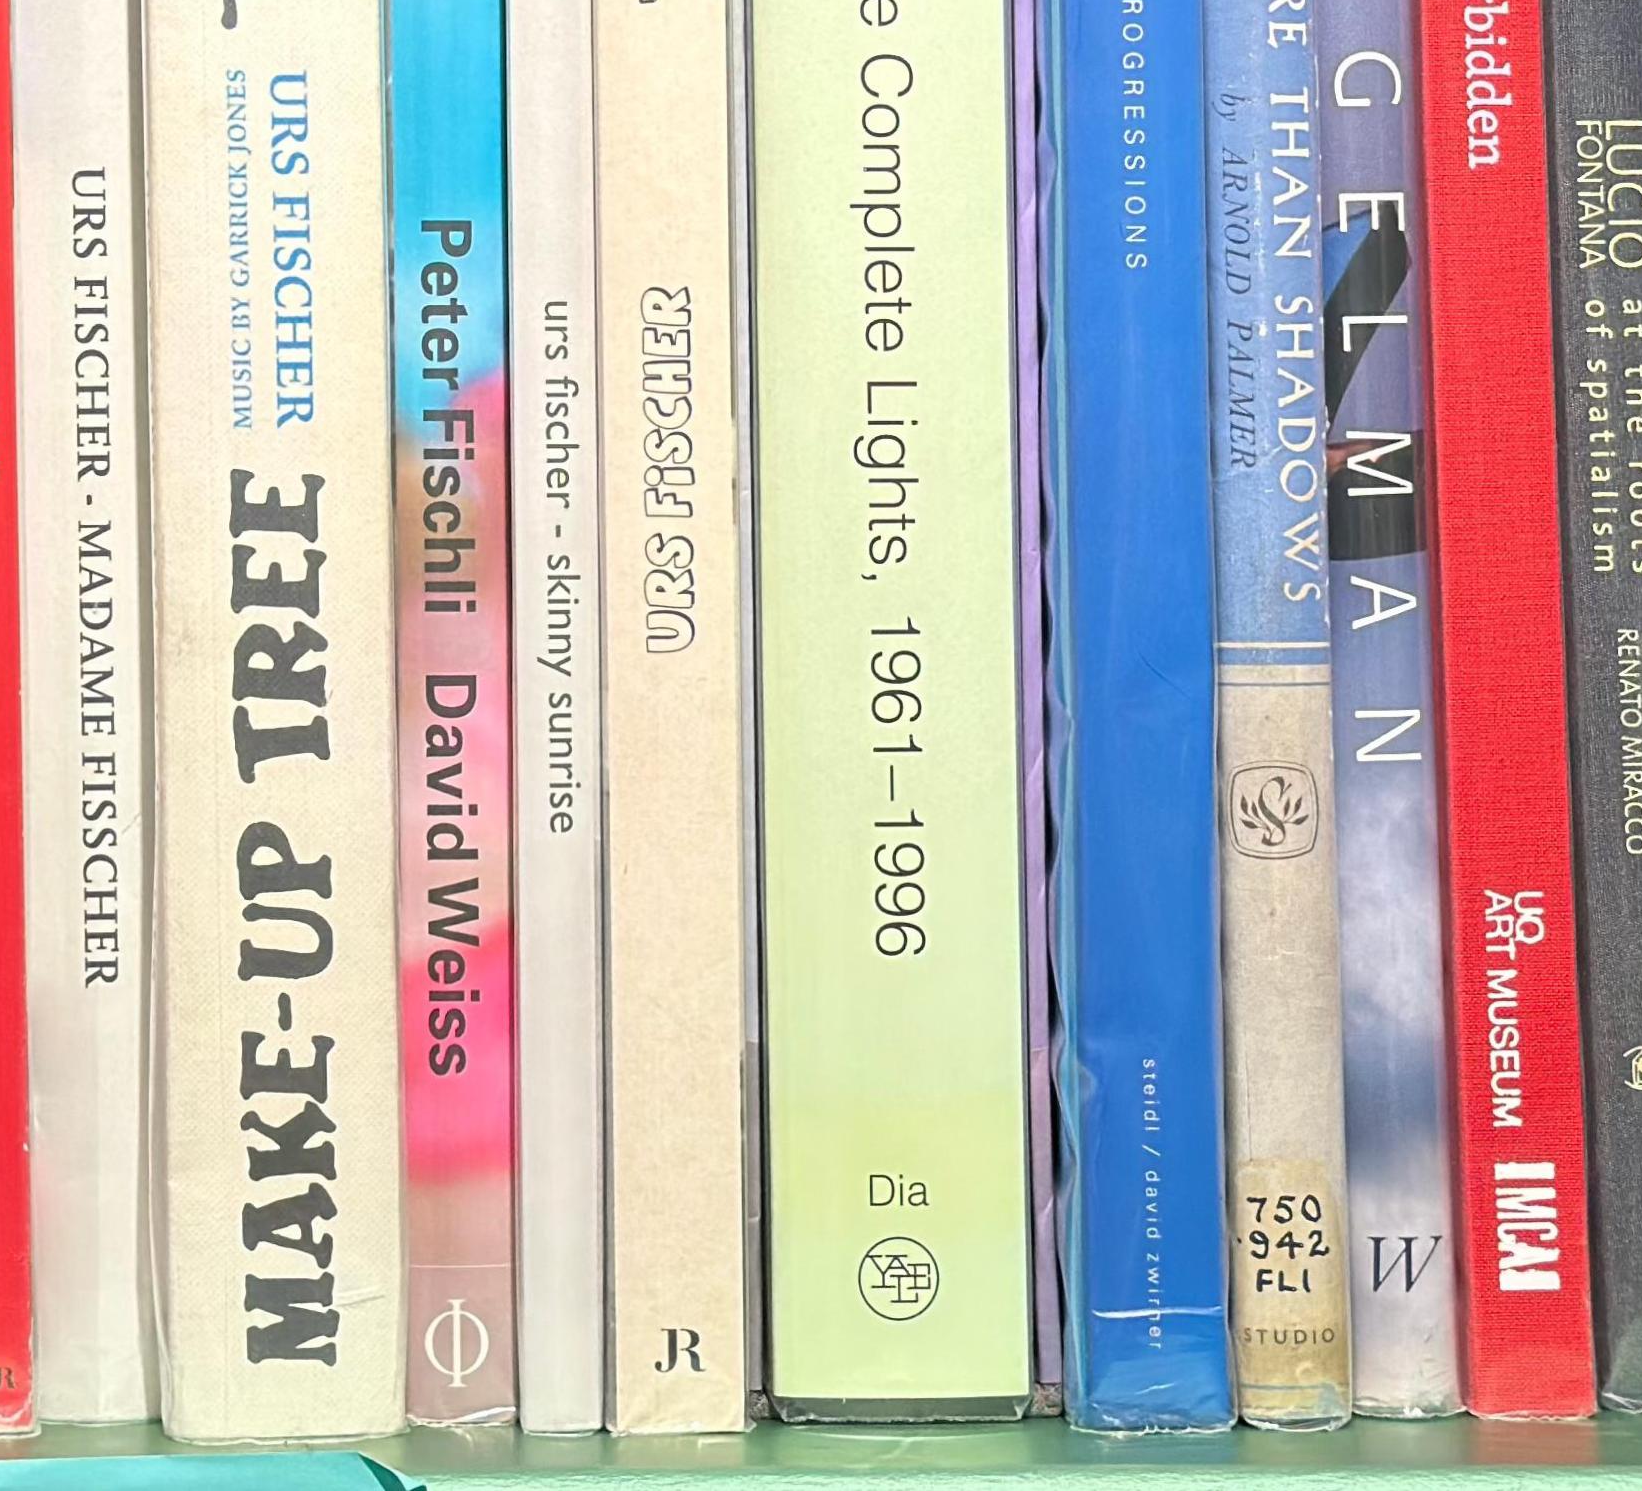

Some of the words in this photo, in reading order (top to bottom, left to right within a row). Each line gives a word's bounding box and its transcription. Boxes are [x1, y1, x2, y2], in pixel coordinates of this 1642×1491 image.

[226, 69, 252, 155] JONES
[269, 69, 310, 175] URS
[1212, 93, 1248, 122] by
[1269, 87, 1312, 260] THAN
[71, 167, 111, 257] URS
[228, 163, 250, 287] GARRICK
[849, 53, 915, 353] Complete
[1220, 146, 1254, 296] ARNOLD
[1575, 119, 1606, 270] FONTANA
[231, 296, 251, 331] BY
[272, 191, 314, 429] FISCHER
[419, 220, 471, 393] Peter
[543, 301, 569, 361] urs
[73, 275, 113, 480] FISCHER
[232, 338, 252, 430] MUSIC
[542, 373, 580, 511] fischer
[1225, 318, 1258, 469] PALMER
[422, 409, 477, 614] Fischli
[852, 381, 919, 580] Lights,
[1274, 295, 1321, 602] SHADOWS
[1586, 360, 1618, 573] spatialism
[78, 520, 116, 737] MADAME
[536, 552, 582, 677] skinny
[645, 533, 696, 655] URS
[424, 674, 478, 862] David
[547, 692, 580, 834] sunrise
[81, 752, 119, 989] FISSCHER
[1483, 888, 1516, 959] ART
[427, 878, 482, 1077] Weiss
[236, 821, 338, 1367] MAKE-UP
[1142, 1058, 1161, 1132] steidl
[1485, 969, 1524, 1128] MUSEUM
[867, 1173, 930, 1209] Dia
[1144, 1170, 1162, 1239] david
[1246, 1194, 1321, 1222] 750
[1146, 1253, 1163, 1350] zwirner
[1243, 1326, 1336, 1345] STUDIO
[1256, 1267, 1311, 1294] FLI
